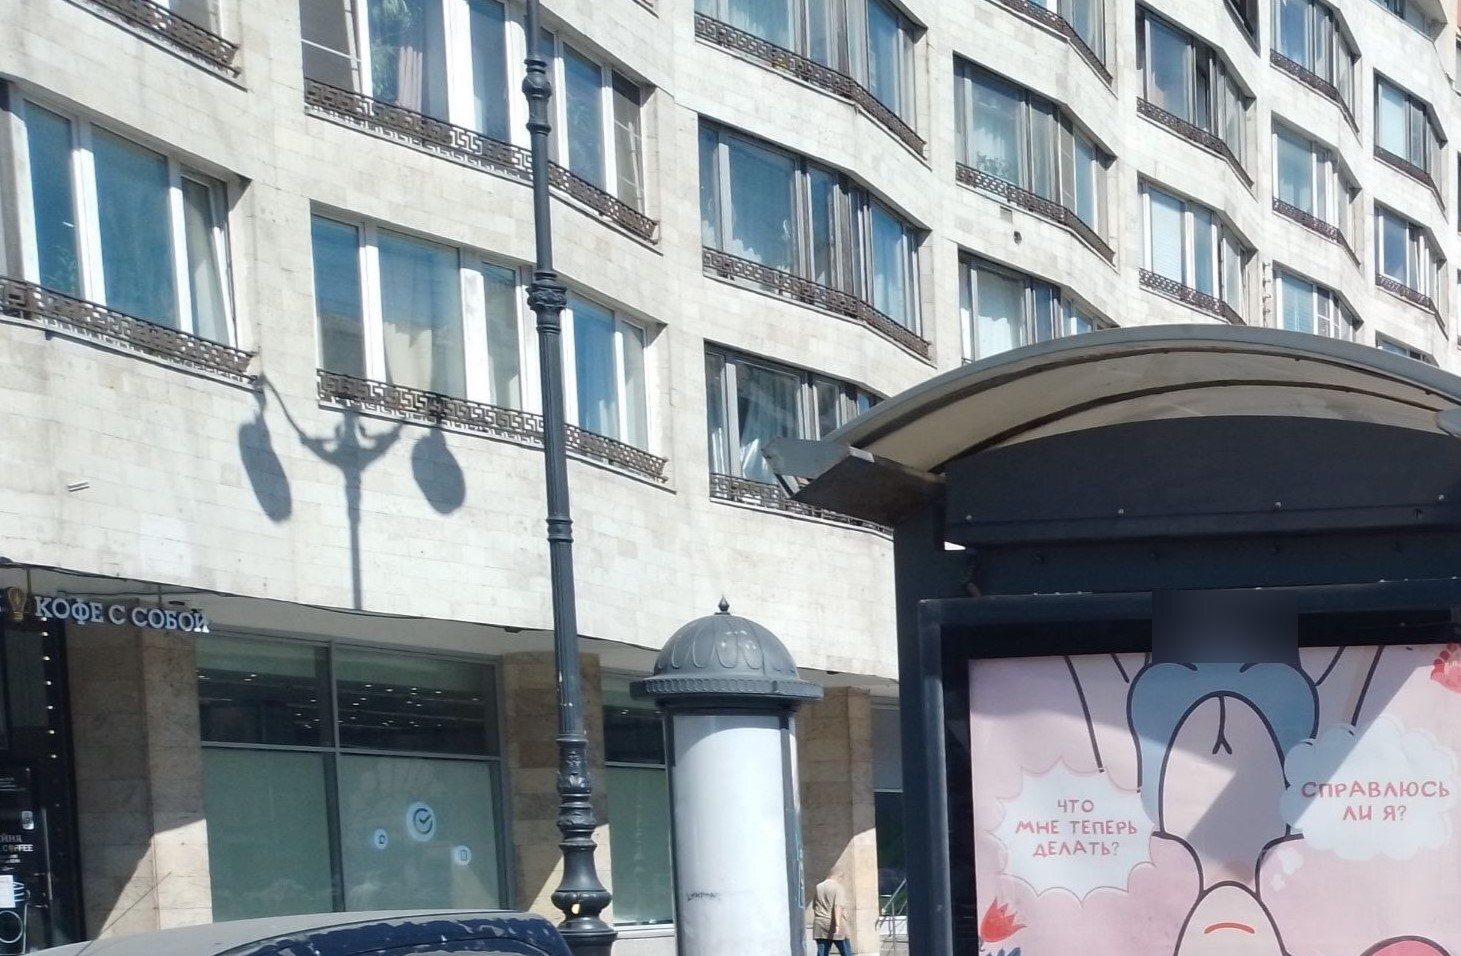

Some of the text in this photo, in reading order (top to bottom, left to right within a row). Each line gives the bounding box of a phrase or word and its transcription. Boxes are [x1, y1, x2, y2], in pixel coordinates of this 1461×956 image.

[35, 596, 210, 633] КОФЕ С СОБОЙ
[1301, 780, 1450, 799] СПРАВЛЮСЬ
[1057, 799, 1094, 813] ЧТО
[1342, 804, 1407, 821] ЛИ Я?
[1015, 819, 1137, 835] МНЕ ТЕПЕРЬ
[1033, 840, 1120, 857] ДЕЛАТЬ?
